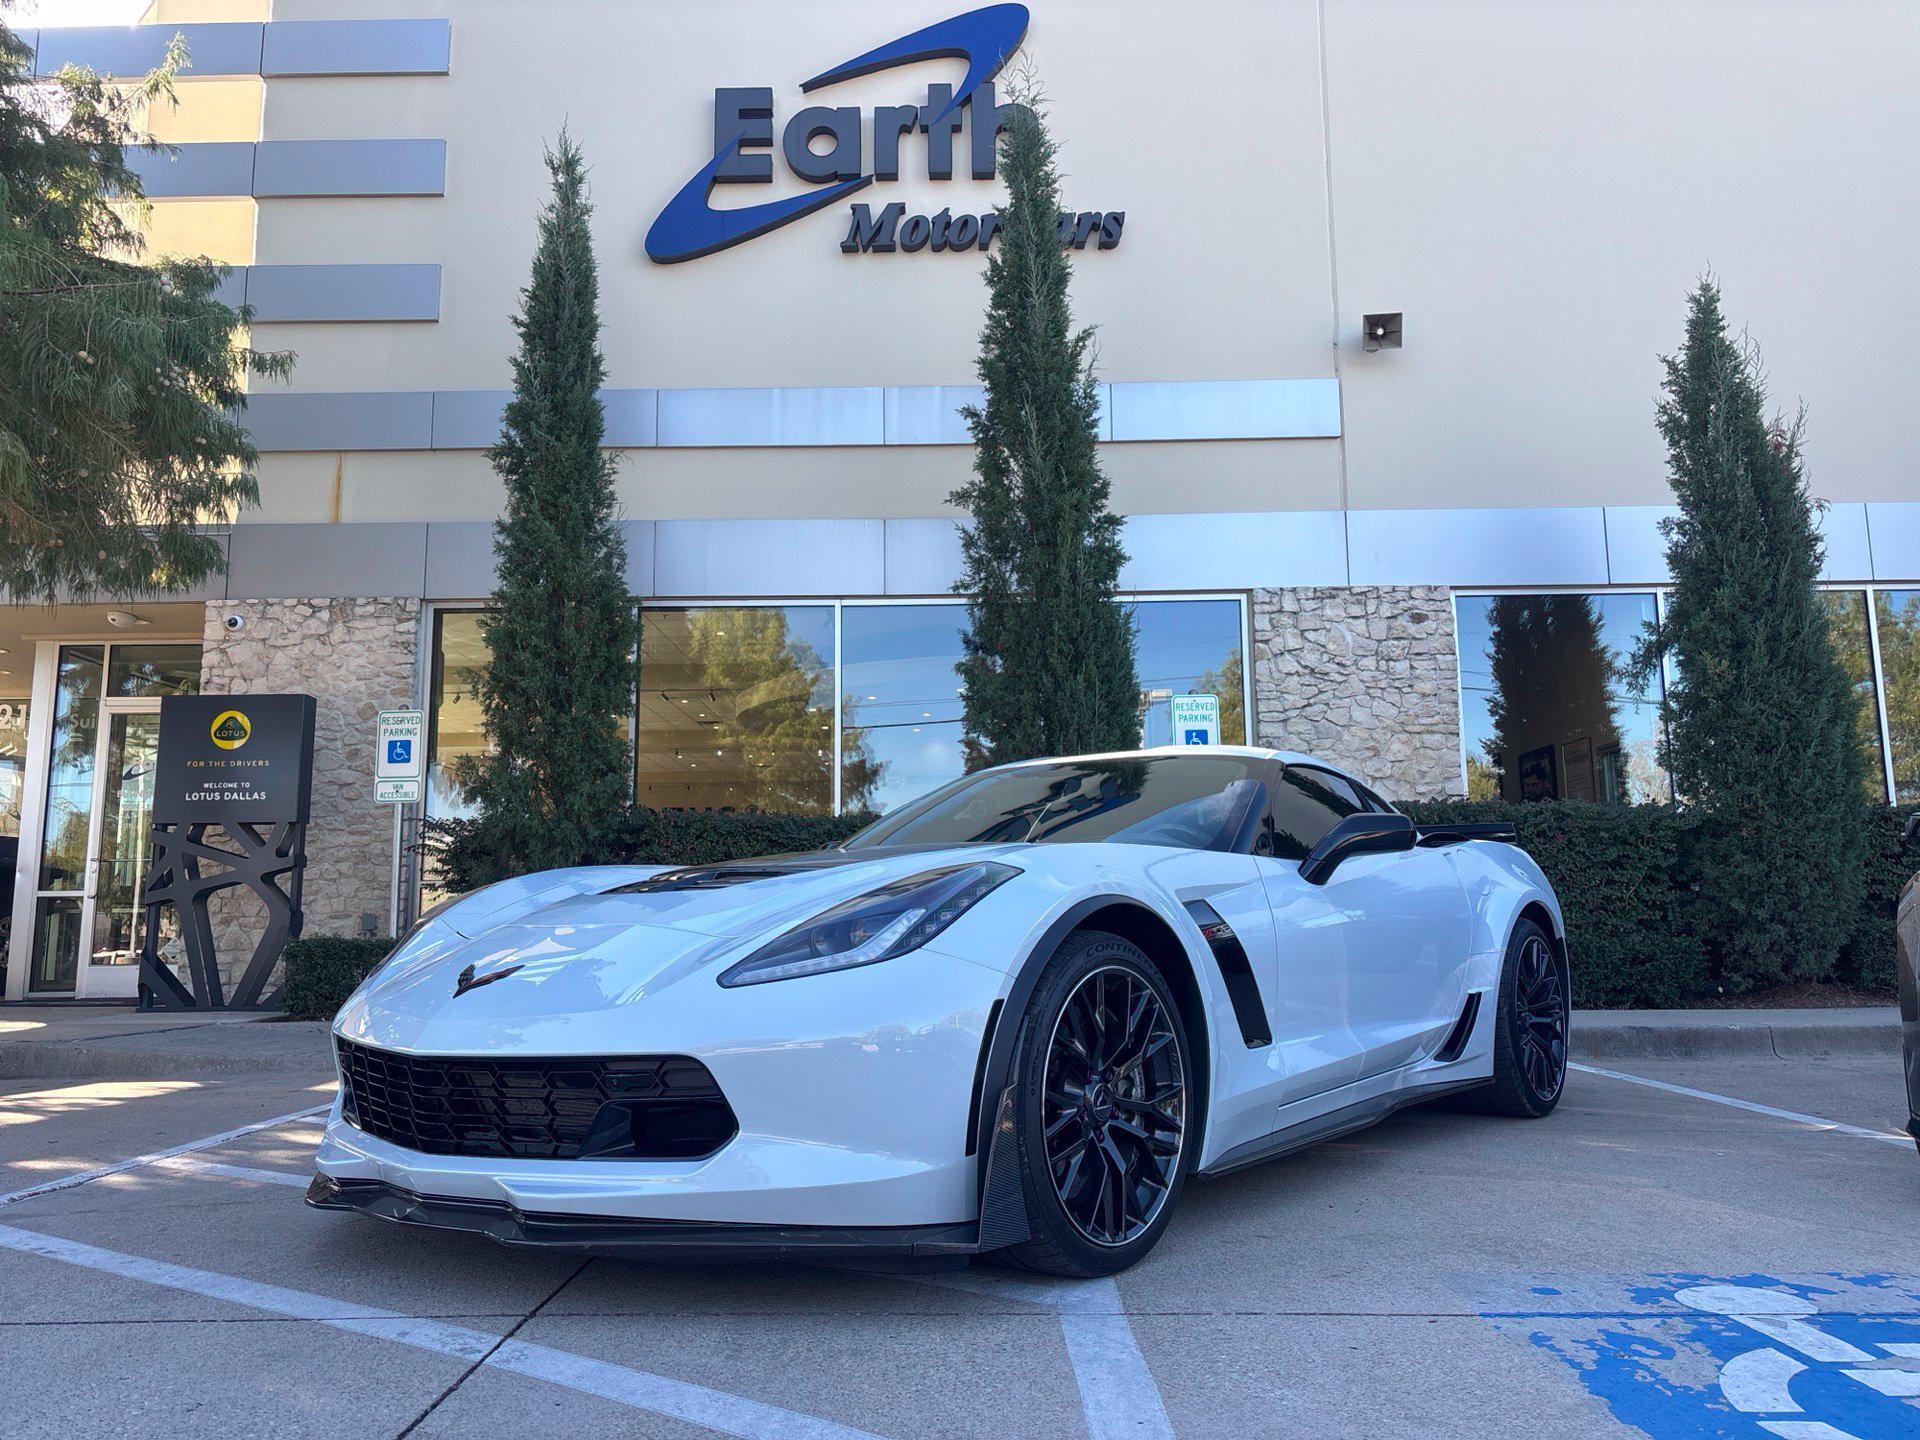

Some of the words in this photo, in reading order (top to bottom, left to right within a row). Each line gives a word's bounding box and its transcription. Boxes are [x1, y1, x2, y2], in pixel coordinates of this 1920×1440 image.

[841, 202, 1126, 253] Motorars
[1176, 702, 1215, 712] RESERVED
[381, 716, 420, 726] RESERVED
[1178, 713, 1213, 723] PARKING
[383, 728, 417, 737] PARKING
[187, 760, 205, 768] FOR
[209, 760, 226, 768] THE
[230, 759, 270, 767] DRIVERS
[185, 792, 220, 801] LOTUS
[224, 791, 267, 801] DALLAS
[380, 791, 416, 799] ACCESSIBLE
